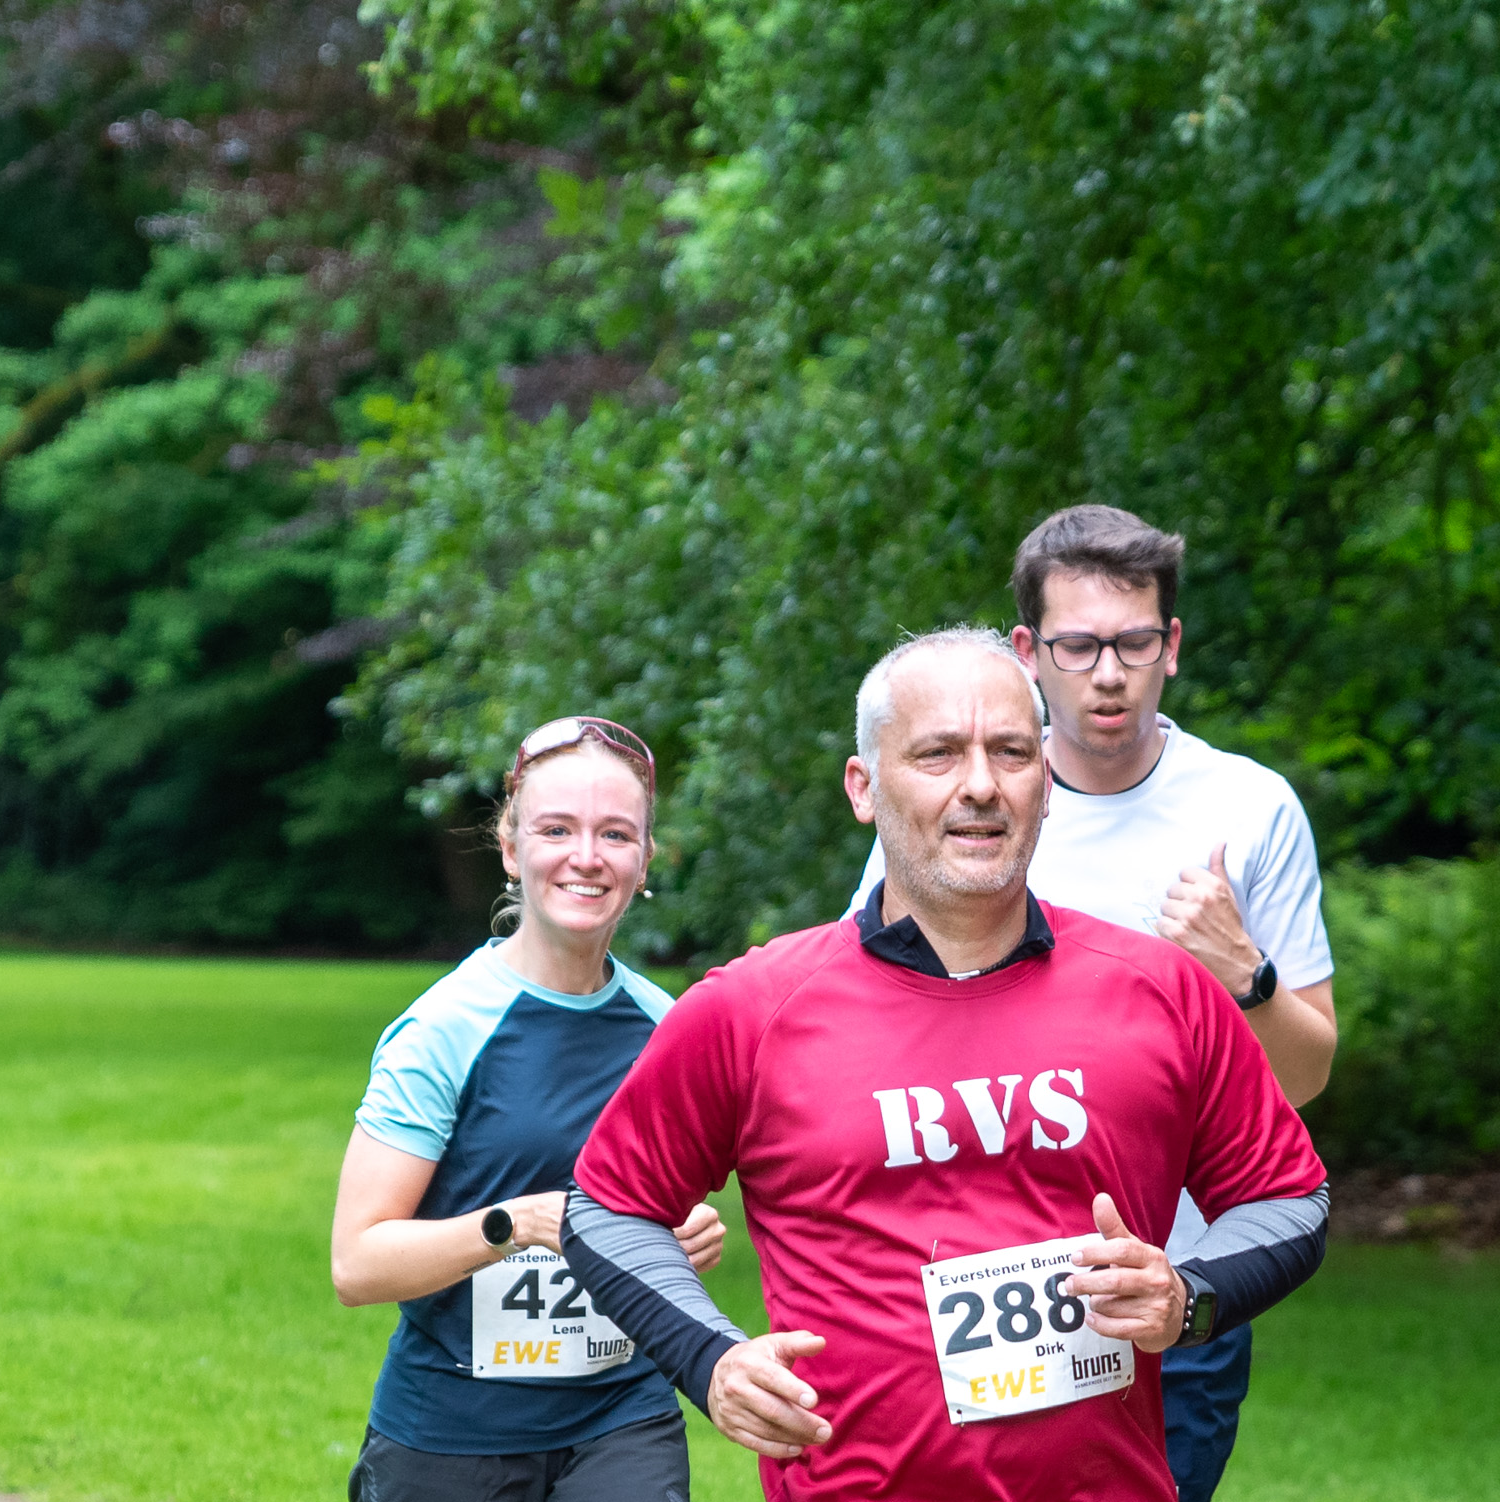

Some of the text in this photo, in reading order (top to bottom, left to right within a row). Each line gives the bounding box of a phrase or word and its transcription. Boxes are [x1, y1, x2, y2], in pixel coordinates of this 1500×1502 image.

[871, 1067, 1089, 1168] RVS
[504, 1252, 561, 1263] erstener
[939, 1262, 1026, 1287] Everstener
[501, 1267, 609, 1320] 42
[938, 1263, 1111, 1356] 288
[552, 1324, 584, 1335] Lena
[492, 1340, 562, 1365] EWE
[586, 1335, 630, 1359] bruns
[1035, 1341, 1066, 1357] Dirk
[1071, 1351, 1122, 1381] bruns
[969, 1364, 1047, 1404] EWE
